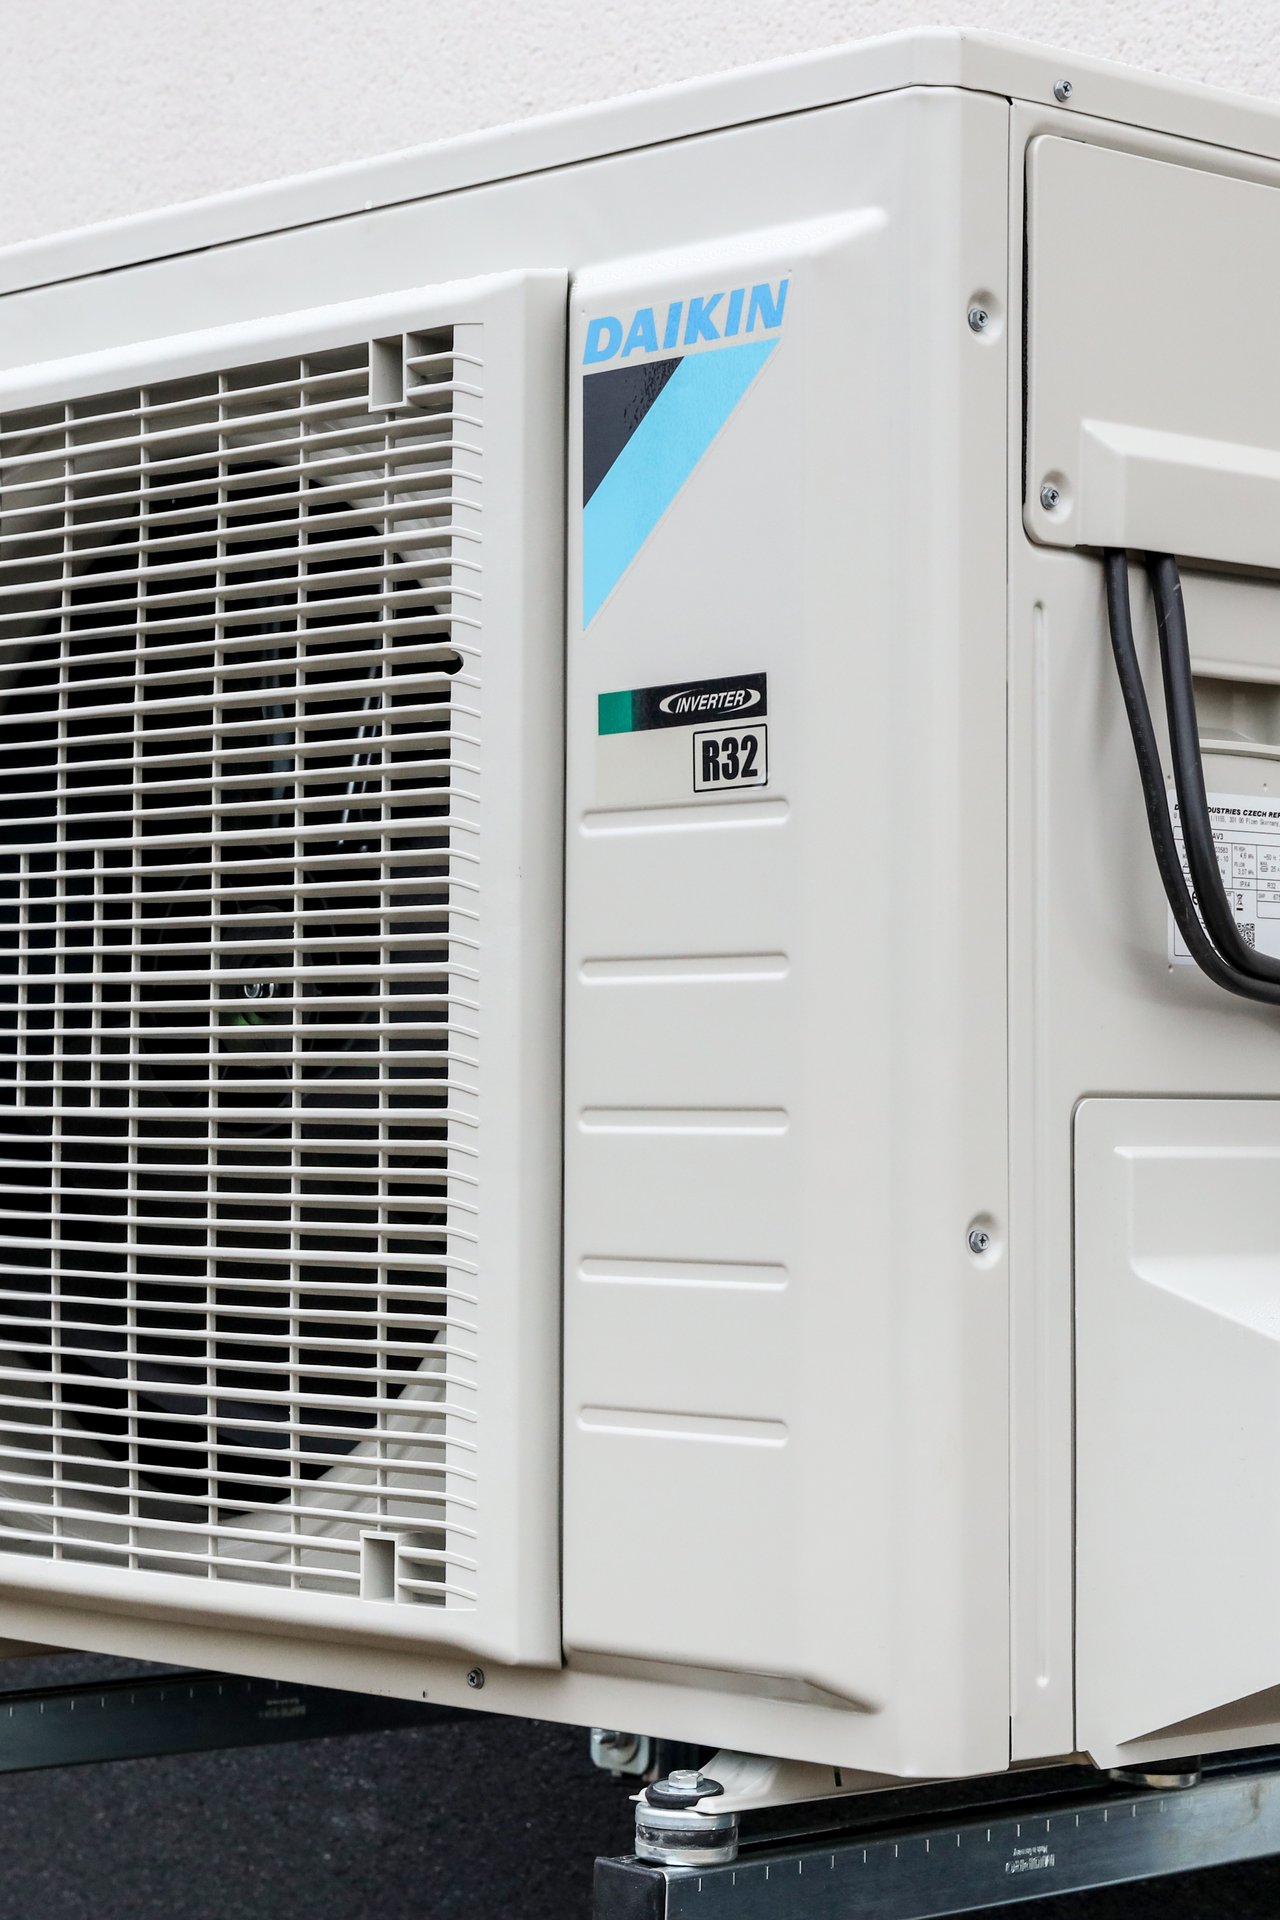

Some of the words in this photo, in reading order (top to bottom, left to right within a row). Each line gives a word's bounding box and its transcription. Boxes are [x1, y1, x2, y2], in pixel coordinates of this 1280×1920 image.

[582, 278, 789, 365] DAIKIN
[675, 690, 746, 713] INVERTER
[702, 734, 758, 782] R32
[1208, 807, 1241, 816] DUSTRIES
[1243, 809, 1267, 818] CZECH
[1268, 811, 1280, 819] REP
[1212, 832, 1224, 841] AV3
